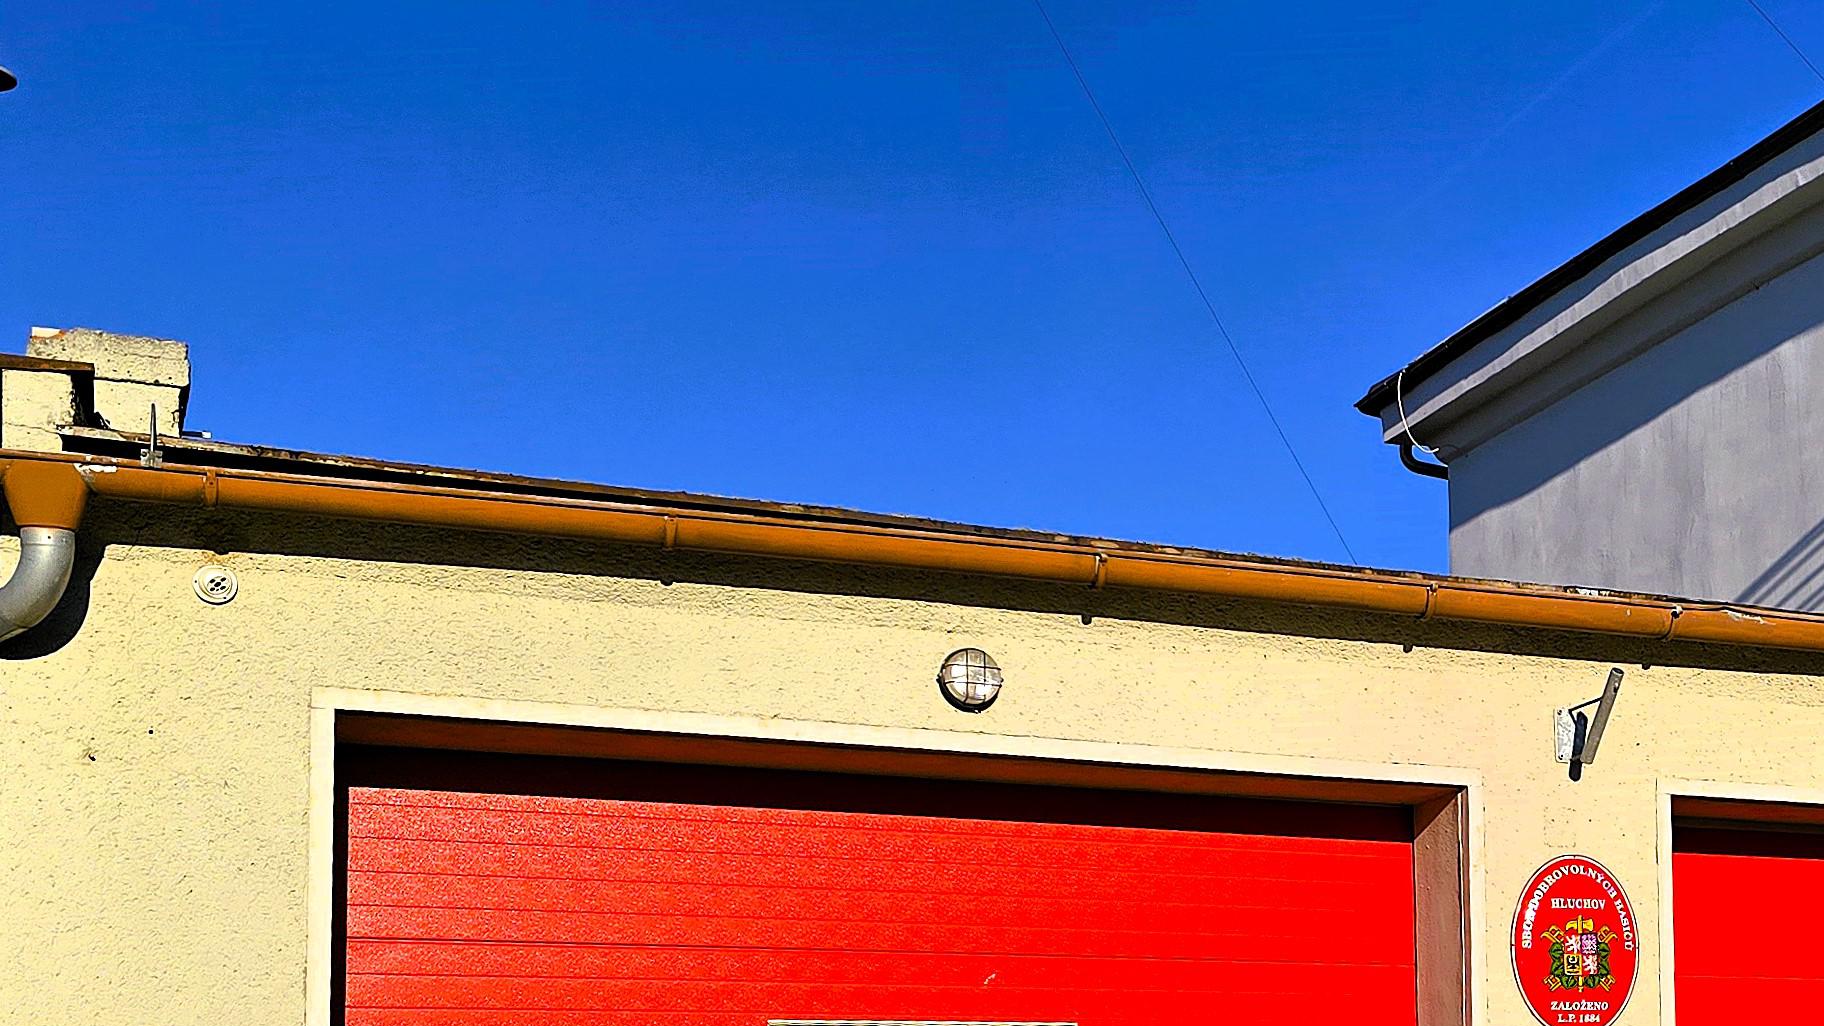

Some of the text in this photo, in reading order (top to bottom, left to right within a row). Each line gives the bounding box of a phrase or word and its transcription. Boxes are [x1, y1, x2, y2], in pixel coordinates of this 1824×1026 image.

[1527, 864, 1618, 911] DOBROVOLNÝCH
[1550, 897, 1606, 910] HLUCHOV
[1550, 999, 1609, 1011] ZALOŽENO
[1579, 1013, 1601, 1023] 1884
